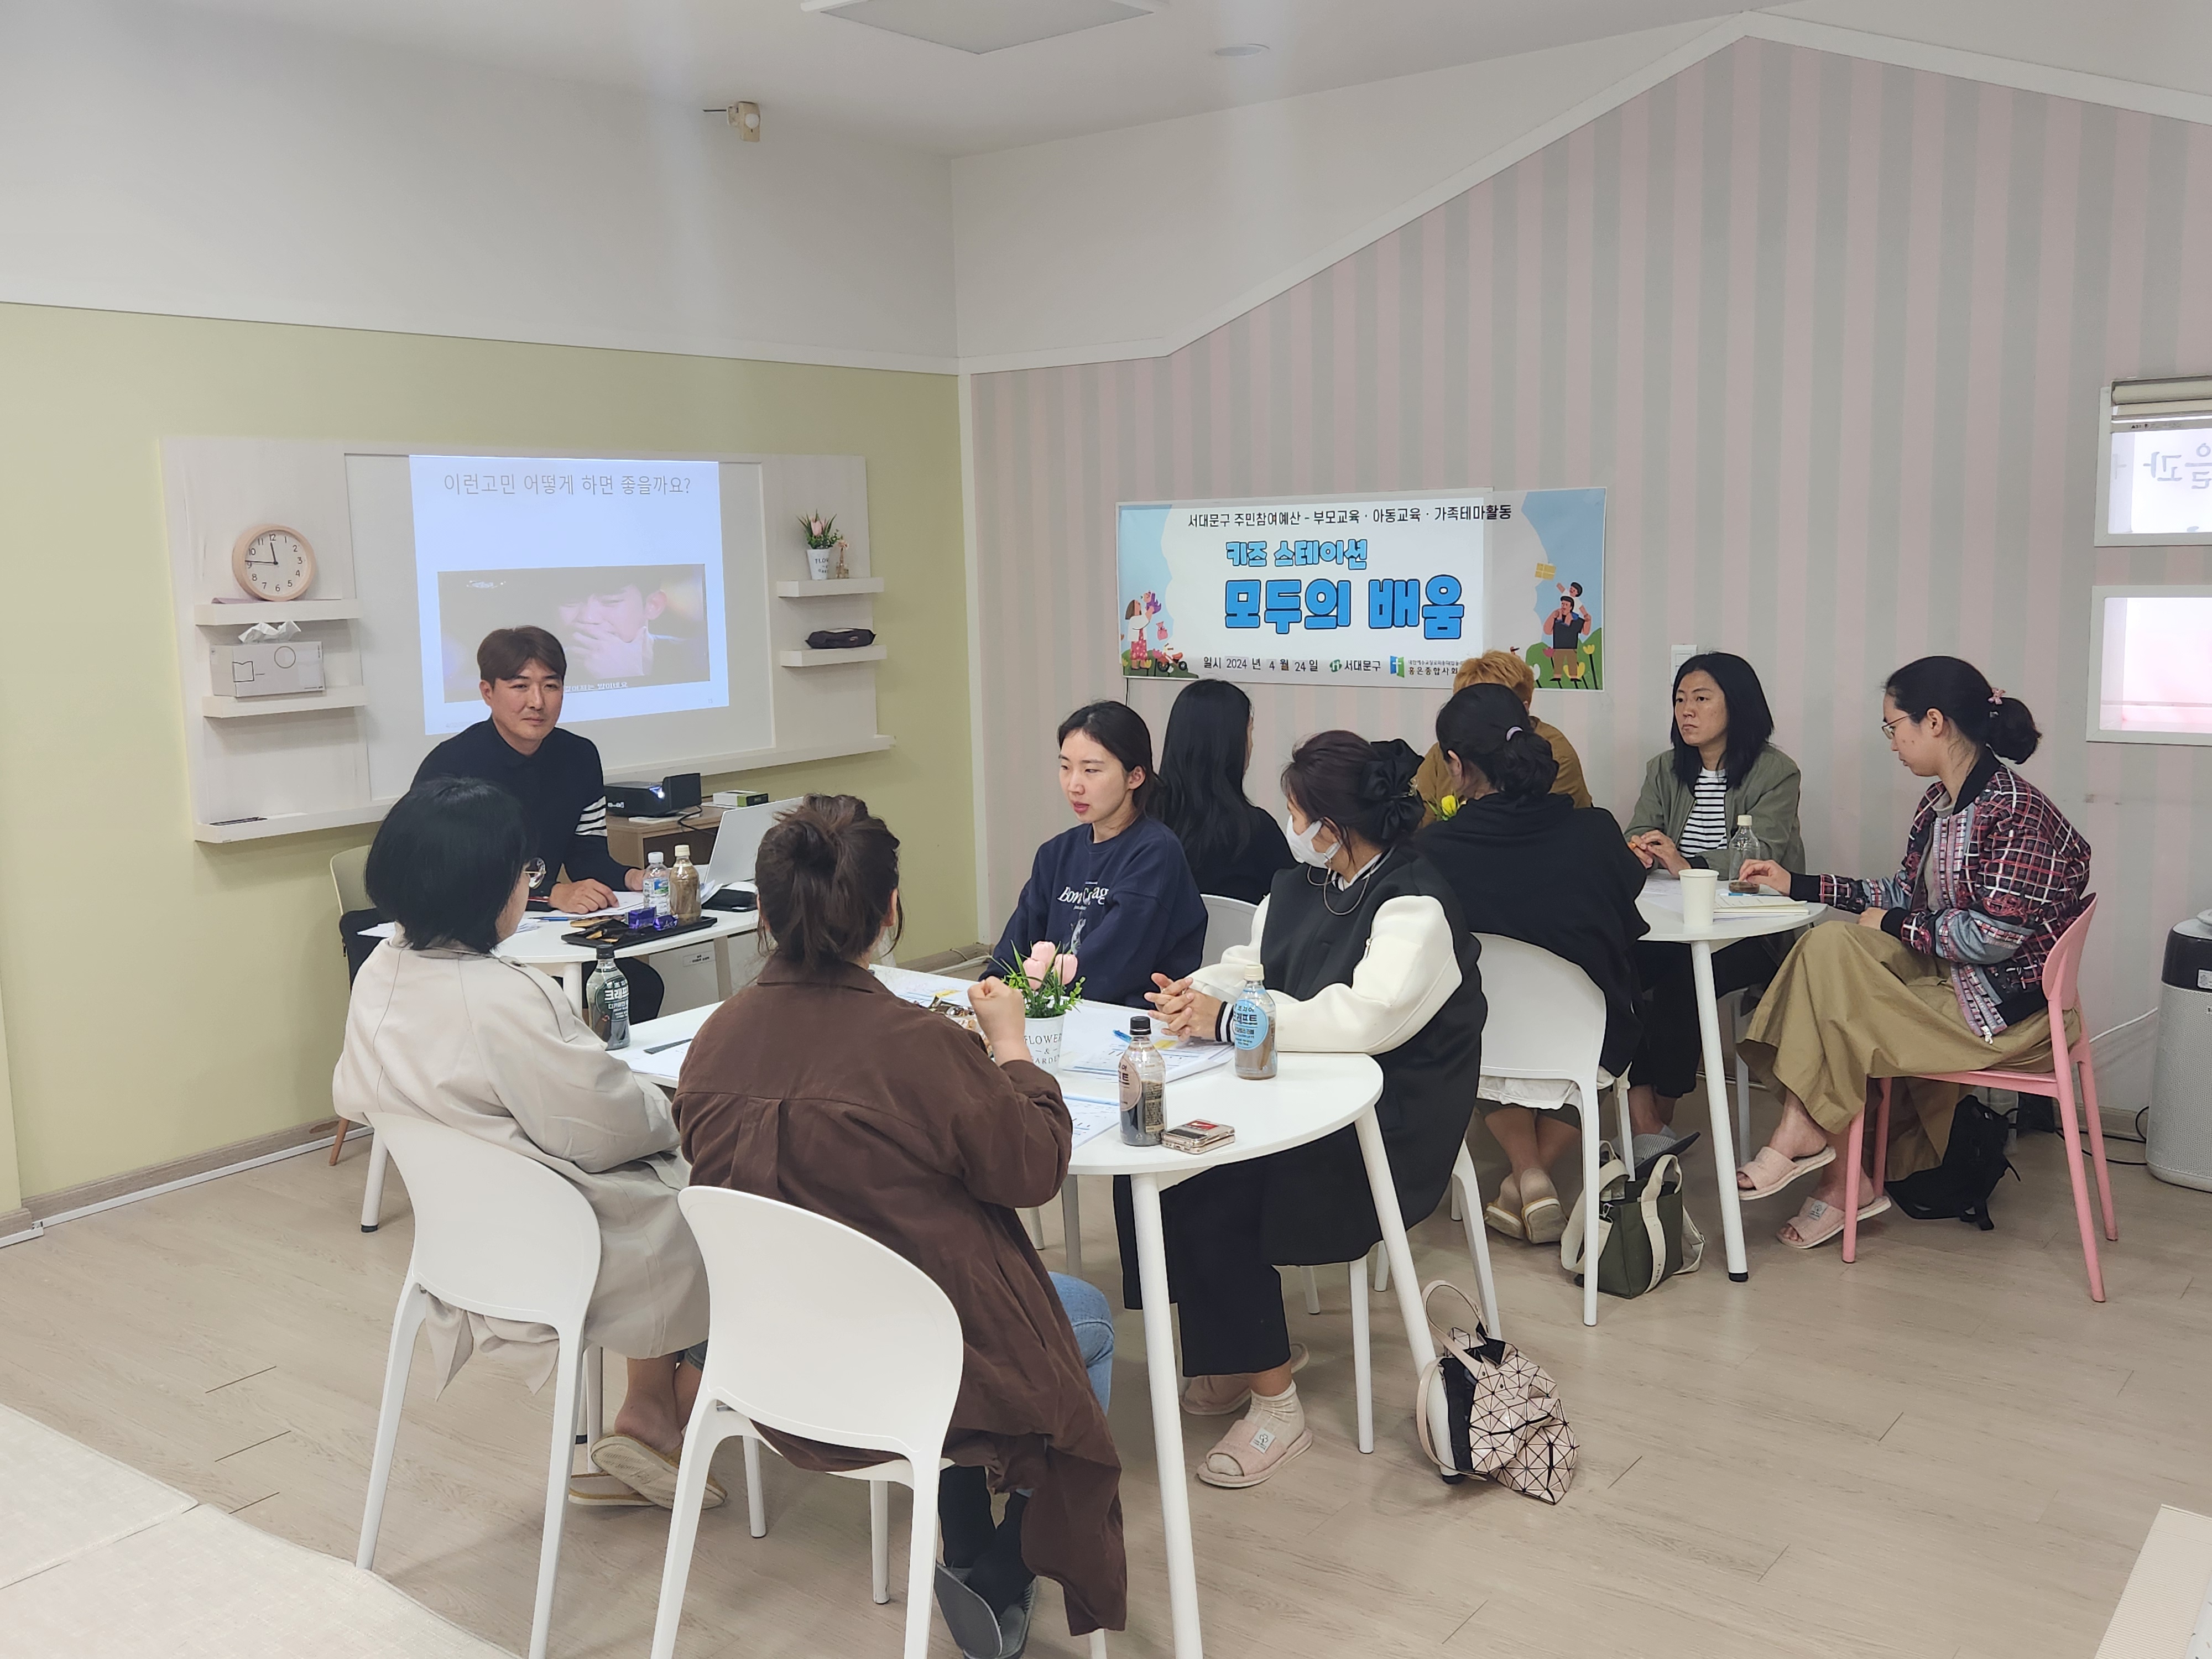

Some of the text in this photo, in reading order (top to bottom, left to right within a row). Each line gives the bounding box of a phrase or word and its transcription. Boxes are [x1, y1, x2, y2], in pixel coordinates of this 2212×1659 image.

[444, 473, 691, 495] 이런고민 어떻게 하면 좋을까요?
[1188, 513, 1230, 528] 서대문구
[1234, 511, 1301, 526] 주민참여예산
[1313, 509, 1360, 524] 부모교육
[1373, 507, 1421, 523] 아동교육
[1434, 504, 1512, 521] 가족테마활동
[248, 547, 256, 556] 10
[1225, 539, 1368, 570] 키즈 스테이션
[1224, 574, 1465, 640] 모두의 배움
[1203, 656, 1319, 672] 일시 2024 년 4 월 24 일
[1344, 660, 1381, 672] 서대문구
[1408, 666, 1458, 675] 홍은종합사회
